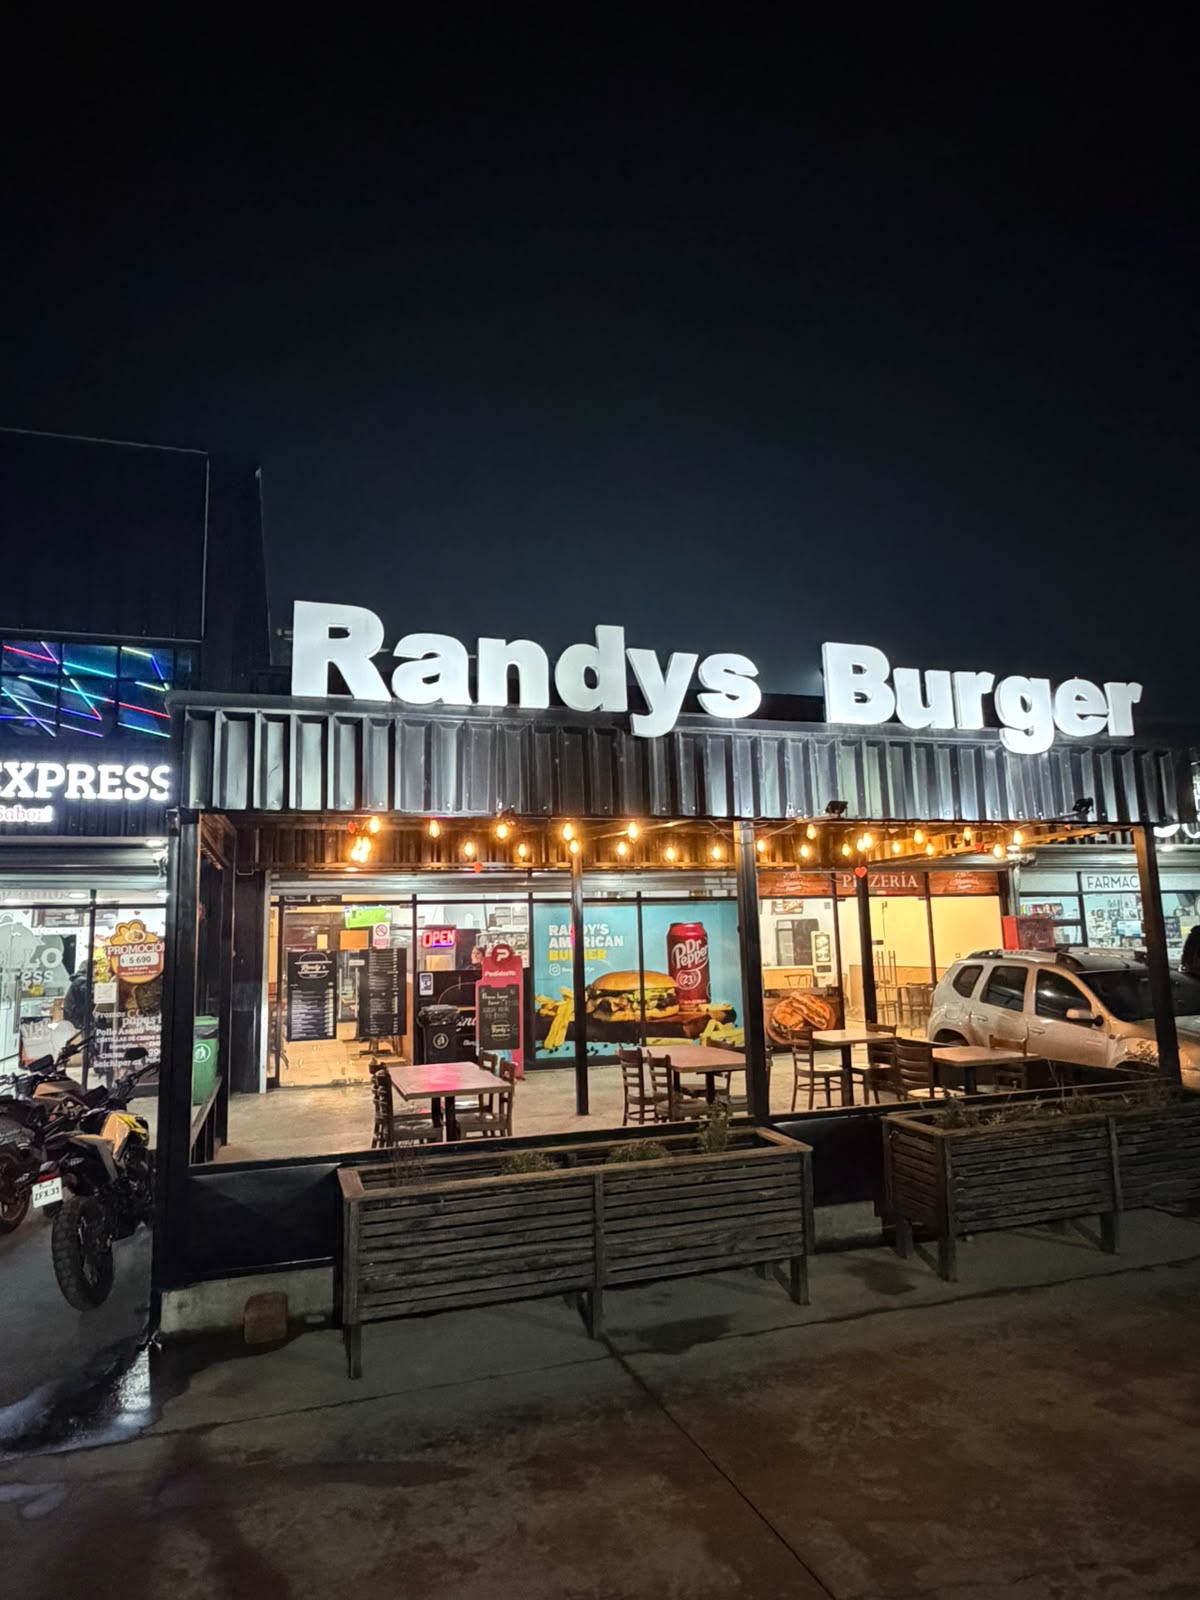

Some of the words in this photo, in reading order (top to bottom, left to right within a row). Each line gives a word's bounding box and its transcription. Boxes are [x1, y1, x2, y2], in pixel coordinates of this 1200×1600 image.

[291, 600, 762, 738] Randys
[821, 641, 1143, 755] Burger
[0, 761, 170, 801] XPRESS
[842, 872, 918, 888] PIZERÍA
[1087, 875, 1139, 889] FARMAC
[548, 923, 609, 936] RAY'S
[421, 929, 456, 948] OPEN
[548, 936, 624, 949] AMRICAN
[686, 938, 702, 954] Dr
[107, 941, 165, 955] PROMOCIÓ
[548, 948, 607, 962] BUER
[671, 943, 708, 968] Pepper
